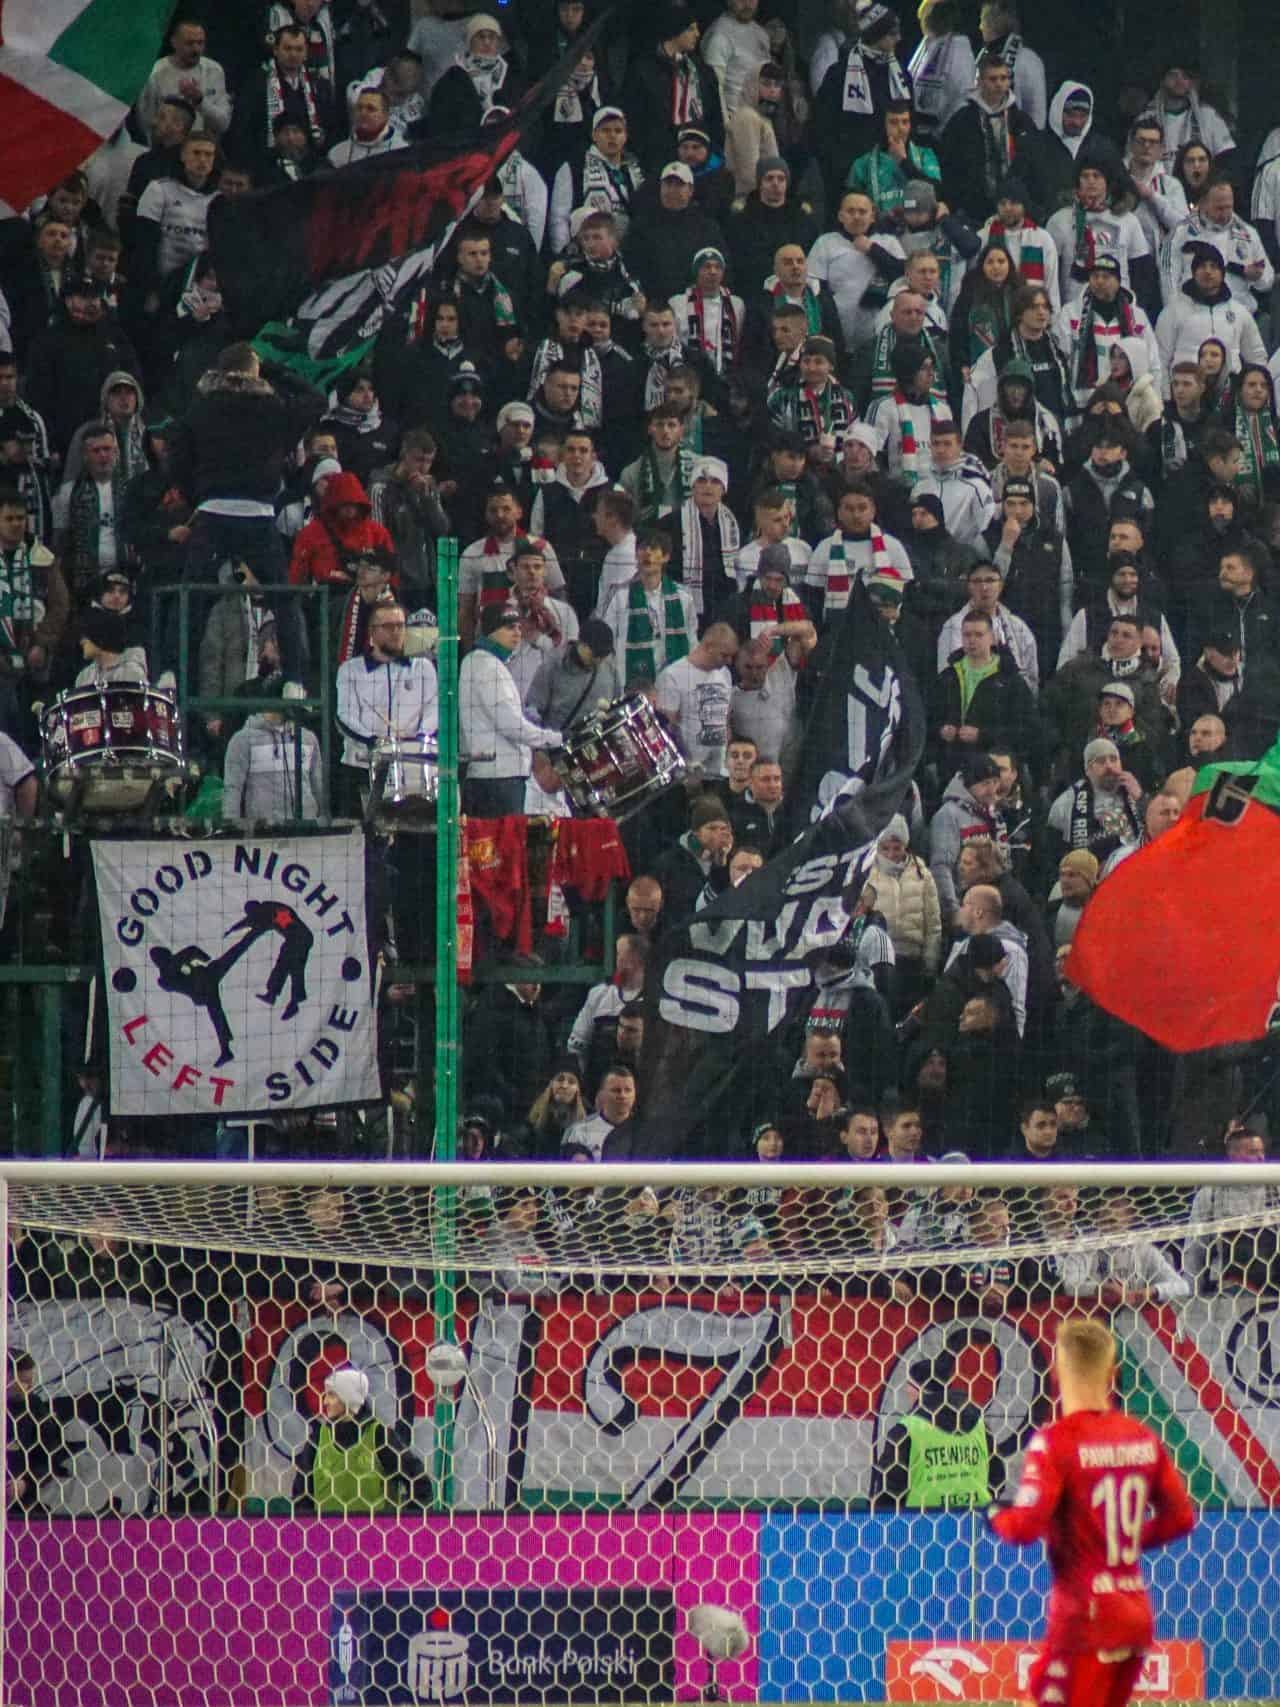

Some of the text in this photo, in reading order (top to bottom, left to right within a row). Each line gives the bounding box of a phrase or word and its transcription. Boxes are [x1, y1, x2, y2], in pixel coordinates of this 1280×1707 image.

[116, 844, 356, 947] GOOD NIGHT
[120, 1003, 359, 1105] LEFT SIDE
[1091, 1473, 1148, 1568] 19
[490, 1648, 636, 1676] Bank Polski
